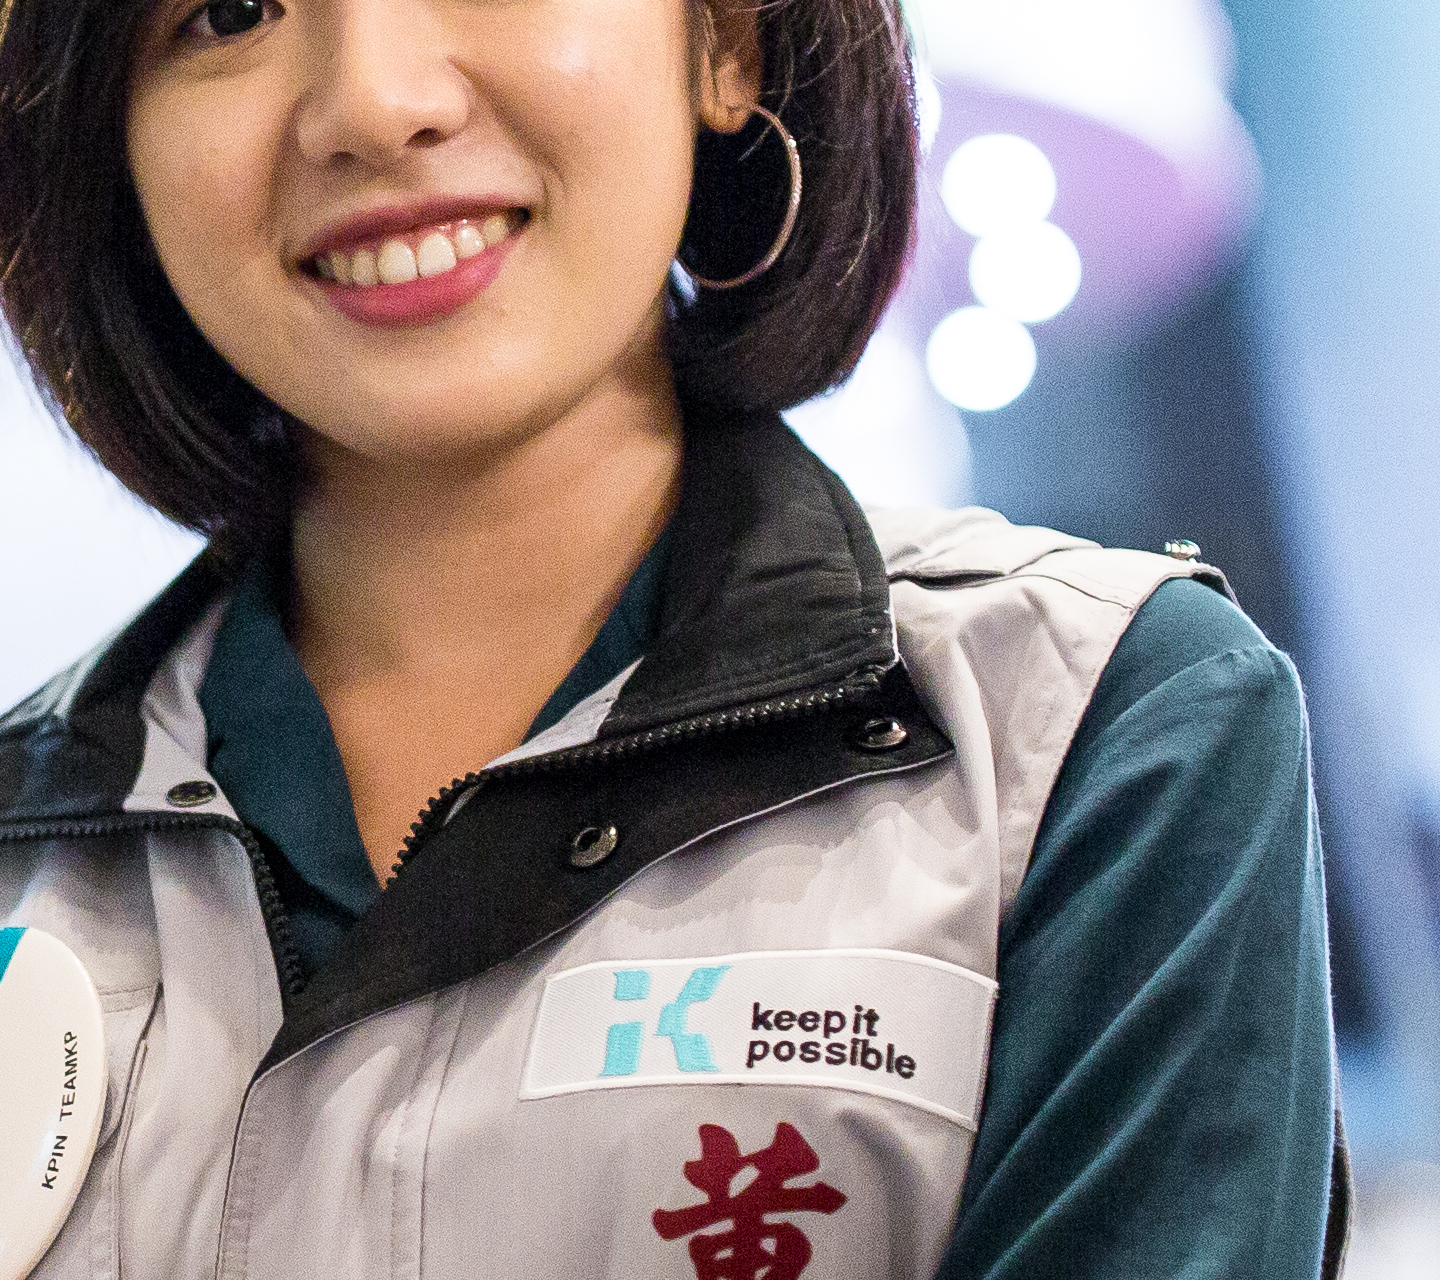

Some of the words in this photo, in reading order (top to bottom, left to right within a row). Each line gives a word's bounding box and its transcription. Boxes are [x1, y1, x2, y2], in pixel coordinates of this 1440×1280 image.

[750, 1001, 846, 1040] keep
[851, 1004, 881, 1038] it
[745, 1037, 918, 1079] possible
[40, 1132, 69, 1191] KPIN
